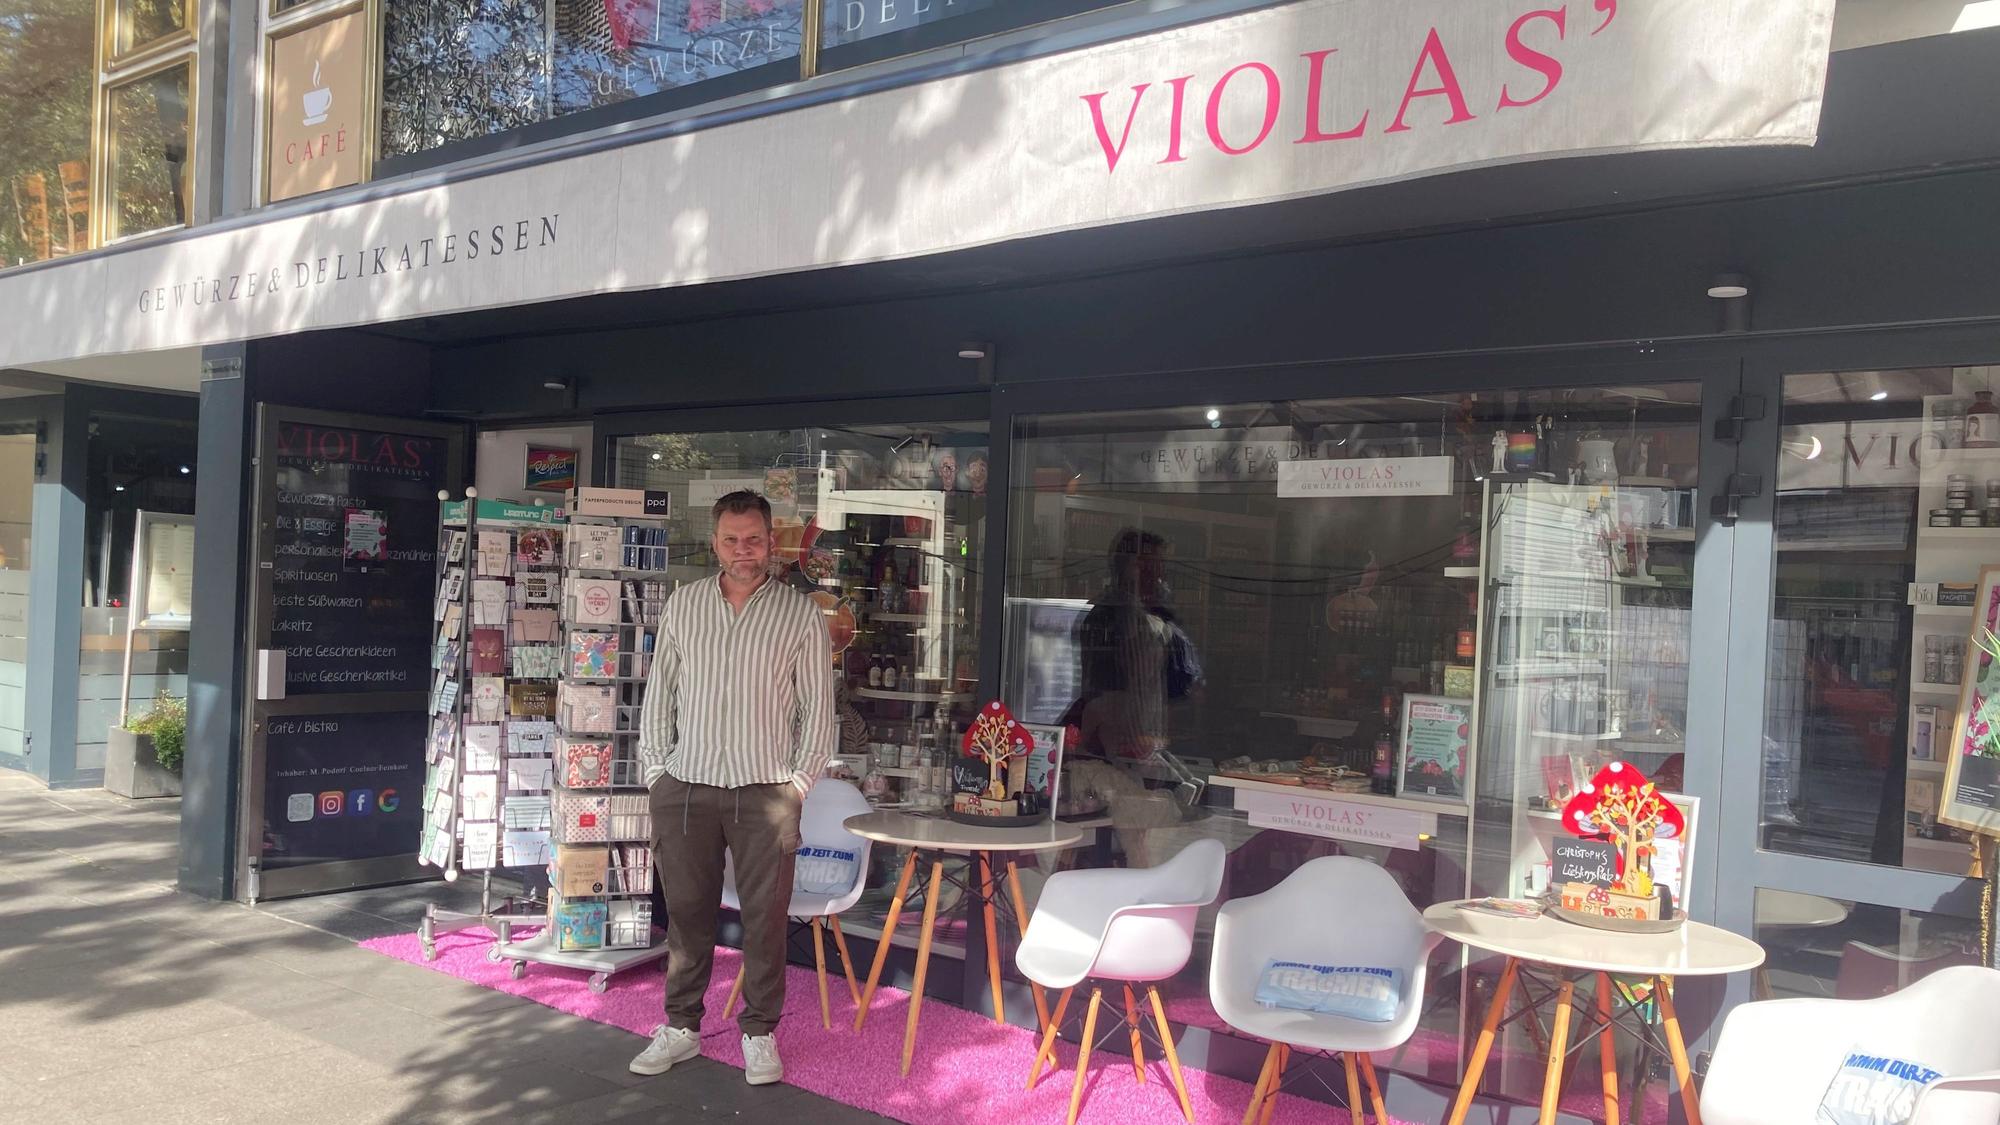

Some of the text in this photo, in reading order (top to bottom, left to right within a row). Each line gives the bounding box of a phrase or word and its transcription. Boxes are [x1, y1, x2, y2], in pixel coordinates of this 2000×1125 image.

[596, 22, 784, 97] GEWÜRZE
[286, 122, 348, 165] CAFÉ
[139, 213, 561, 315] GEWÜRZE & DELIKATESSEN
[1354, 480, 1422, 490] DELIKATESSEN
[647, 498, 666, 508] ppd
[303, 518, 337, 536] Essige
[274, 568, 338, 584] Spirituosen
[273, 593, 363, 608] beste Süßwaren
[271, 620, 313, 633] Lakritz
[315, 644, 397, 657] Geschenkideen
[319, 669, 407, 682] Geschenkartikel
[267, 720, 294, 736] Café
[304, 720, 339, 734] Bistro
[812, 848, 831, 858] ZEIT
[832, 850, 854, 862] ZUM
